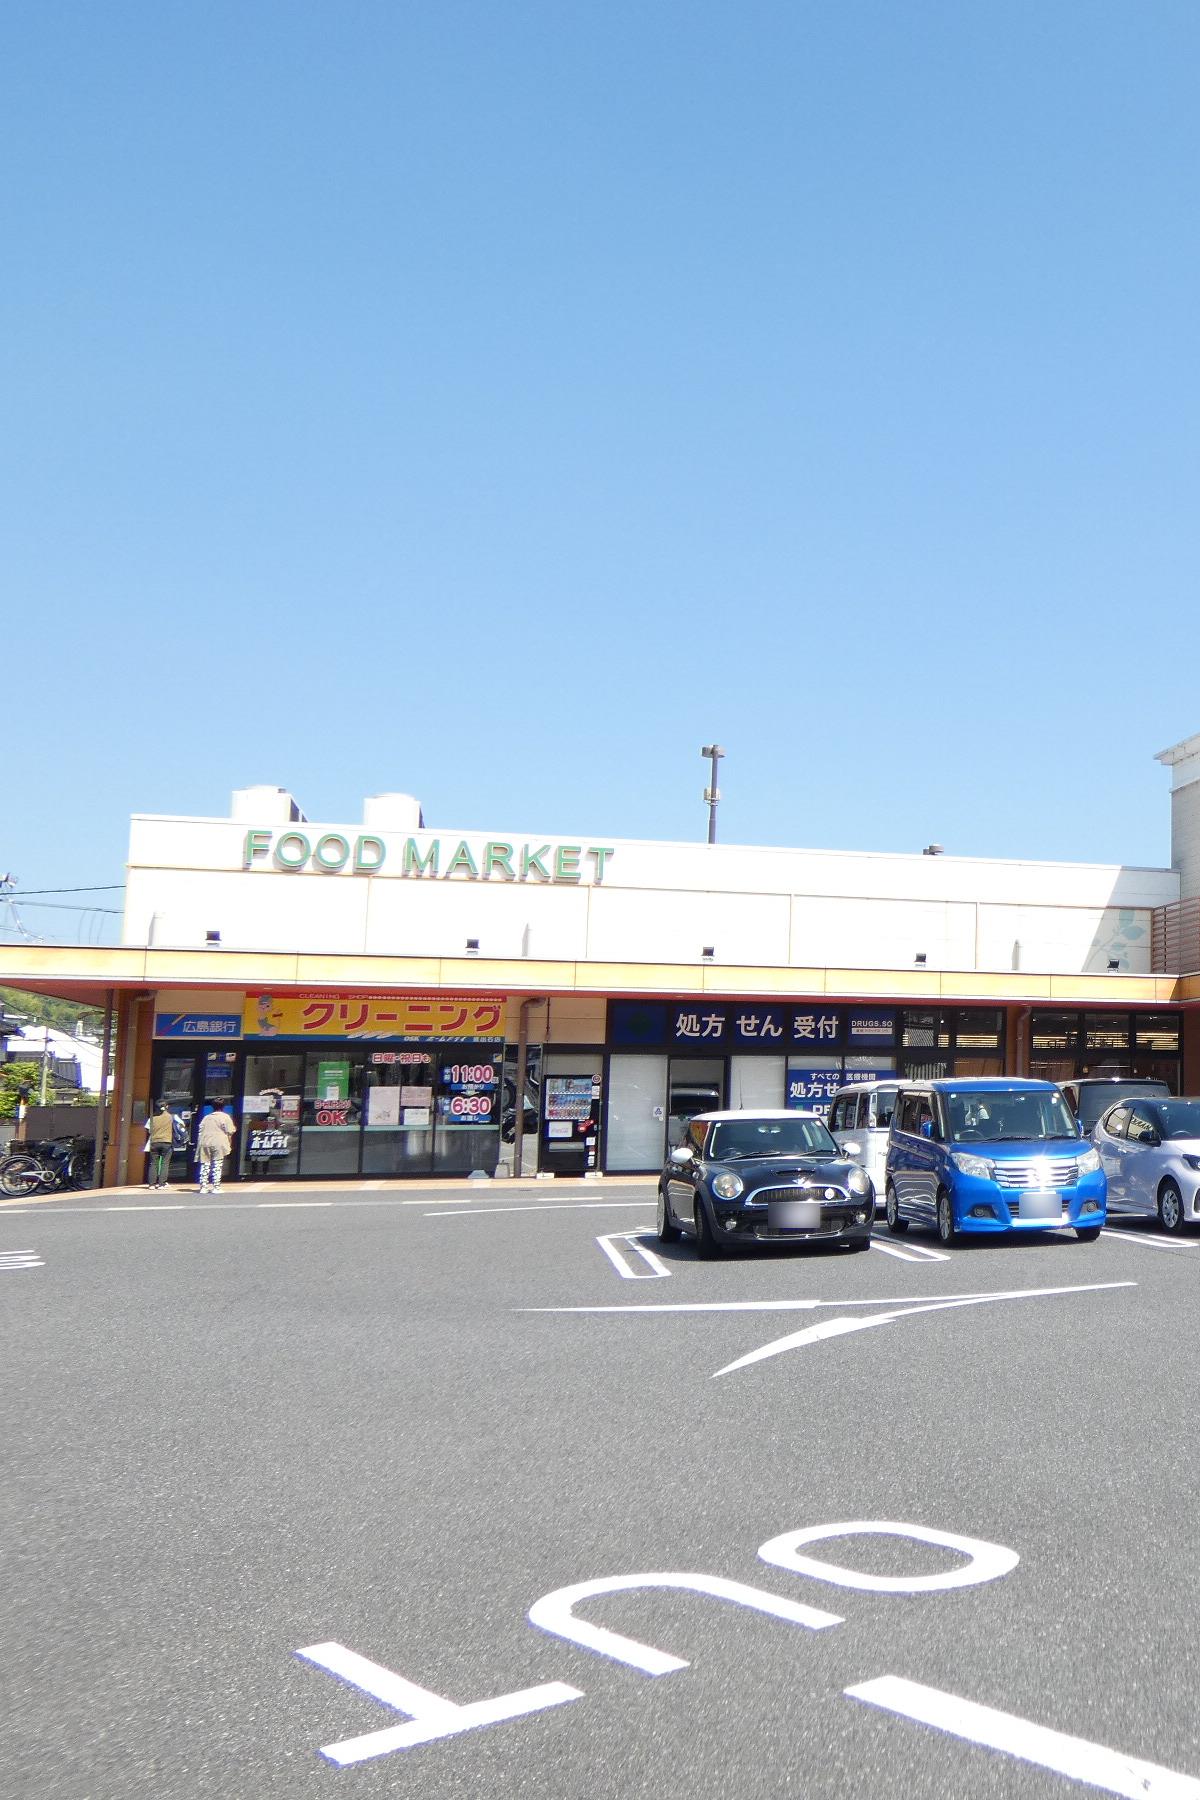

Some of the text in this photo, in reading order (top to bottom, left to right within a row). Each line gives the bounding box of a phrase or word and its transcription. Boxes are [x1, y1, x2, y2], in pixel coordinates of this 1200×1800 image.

[244, 829, 615, 881] FOOD MARKET
[182, 1020, 237, 1033] 広島銀行
[302, 1003, 502, 1032] クリーニング
[675, 1013, 839, 1039] 処方 せん 受付
[451, 1064, 494, 1083] 11:00
[809, 1073, 840, 1081] すべての
[451, 1096, 491, 1115] 6:30
[316, 1110, 349, 1125] OK
[294, 1520, 1020, 1767] OUT
